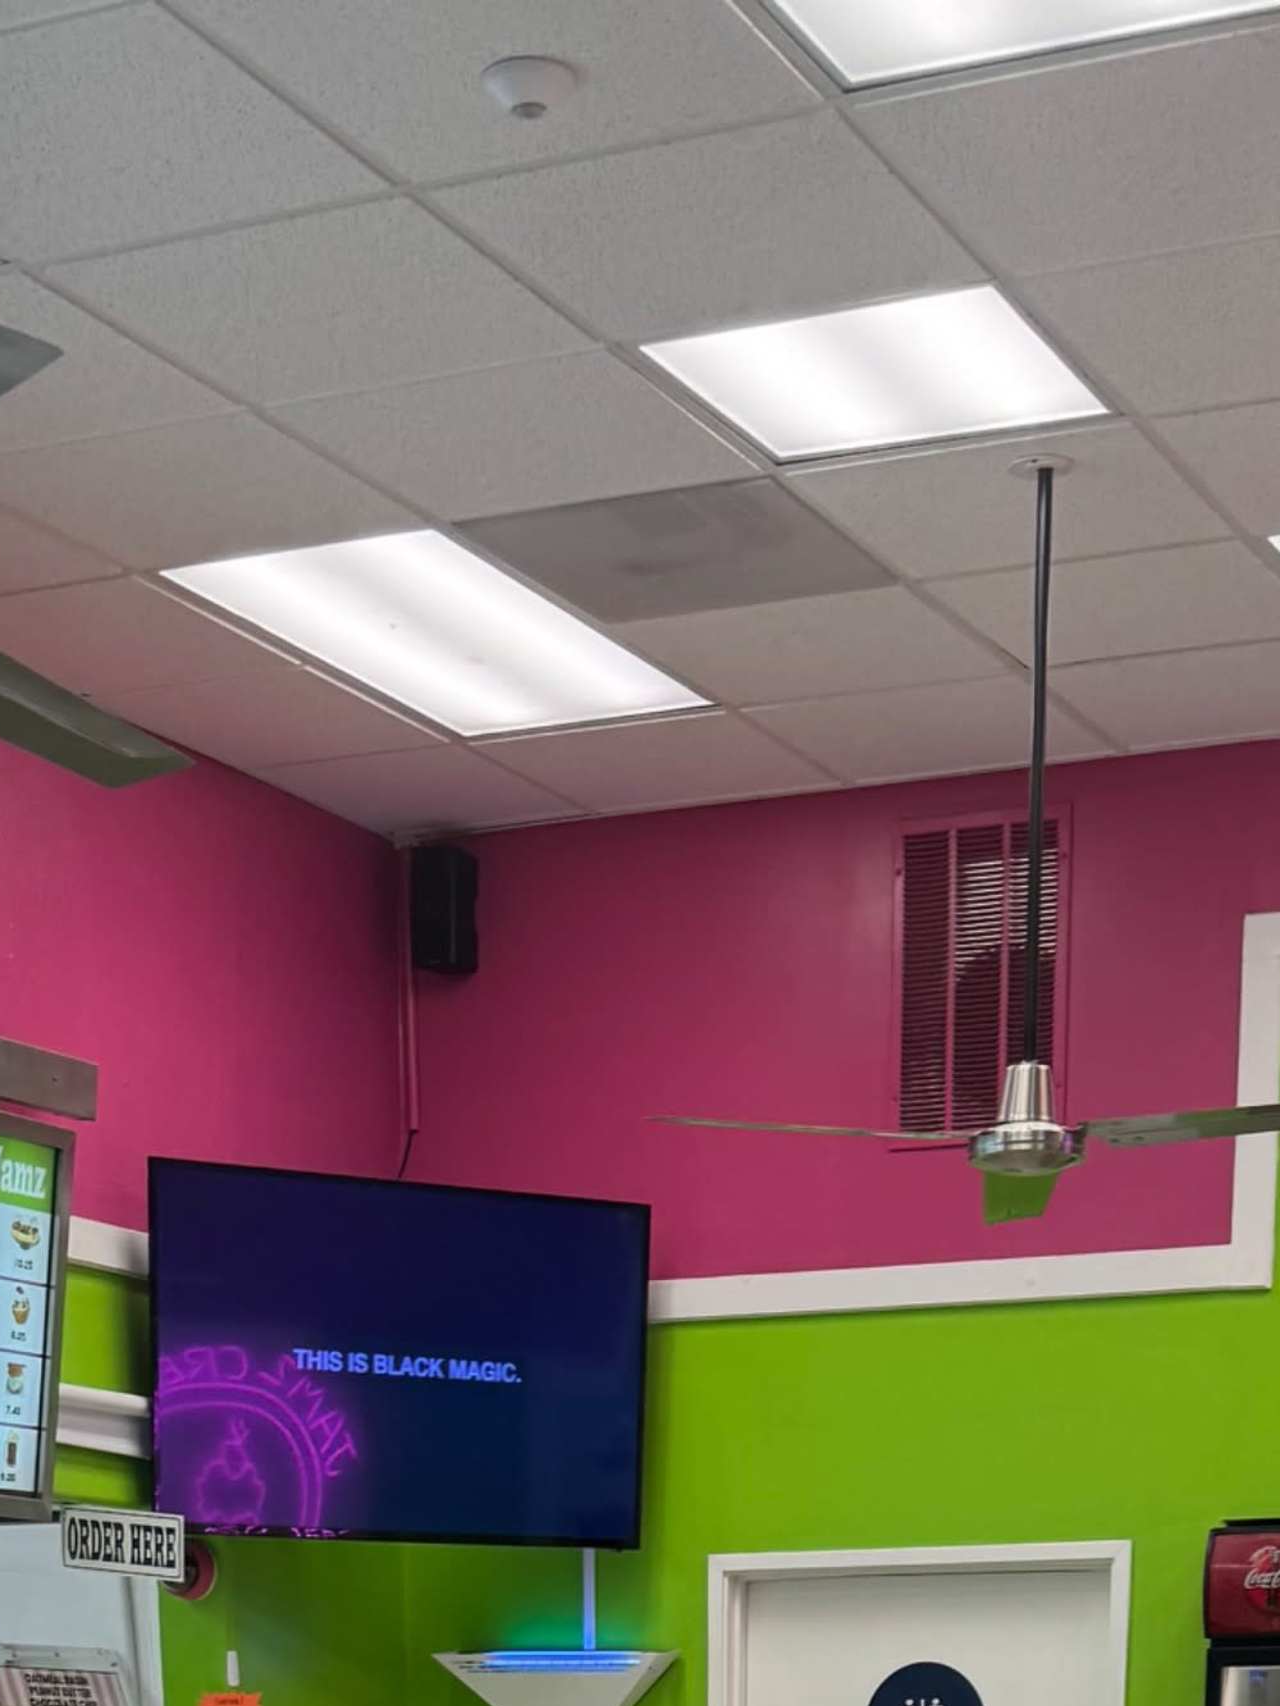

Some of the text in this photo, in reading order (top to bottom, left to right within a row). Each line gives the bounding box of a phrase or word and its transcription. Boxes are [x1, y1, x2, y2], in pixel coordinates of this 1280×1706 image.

[293, 1347, 523, 1384] THIS IS BLACK MAGIC.
[68, 1516, 176, 1569] ORDER HERE
